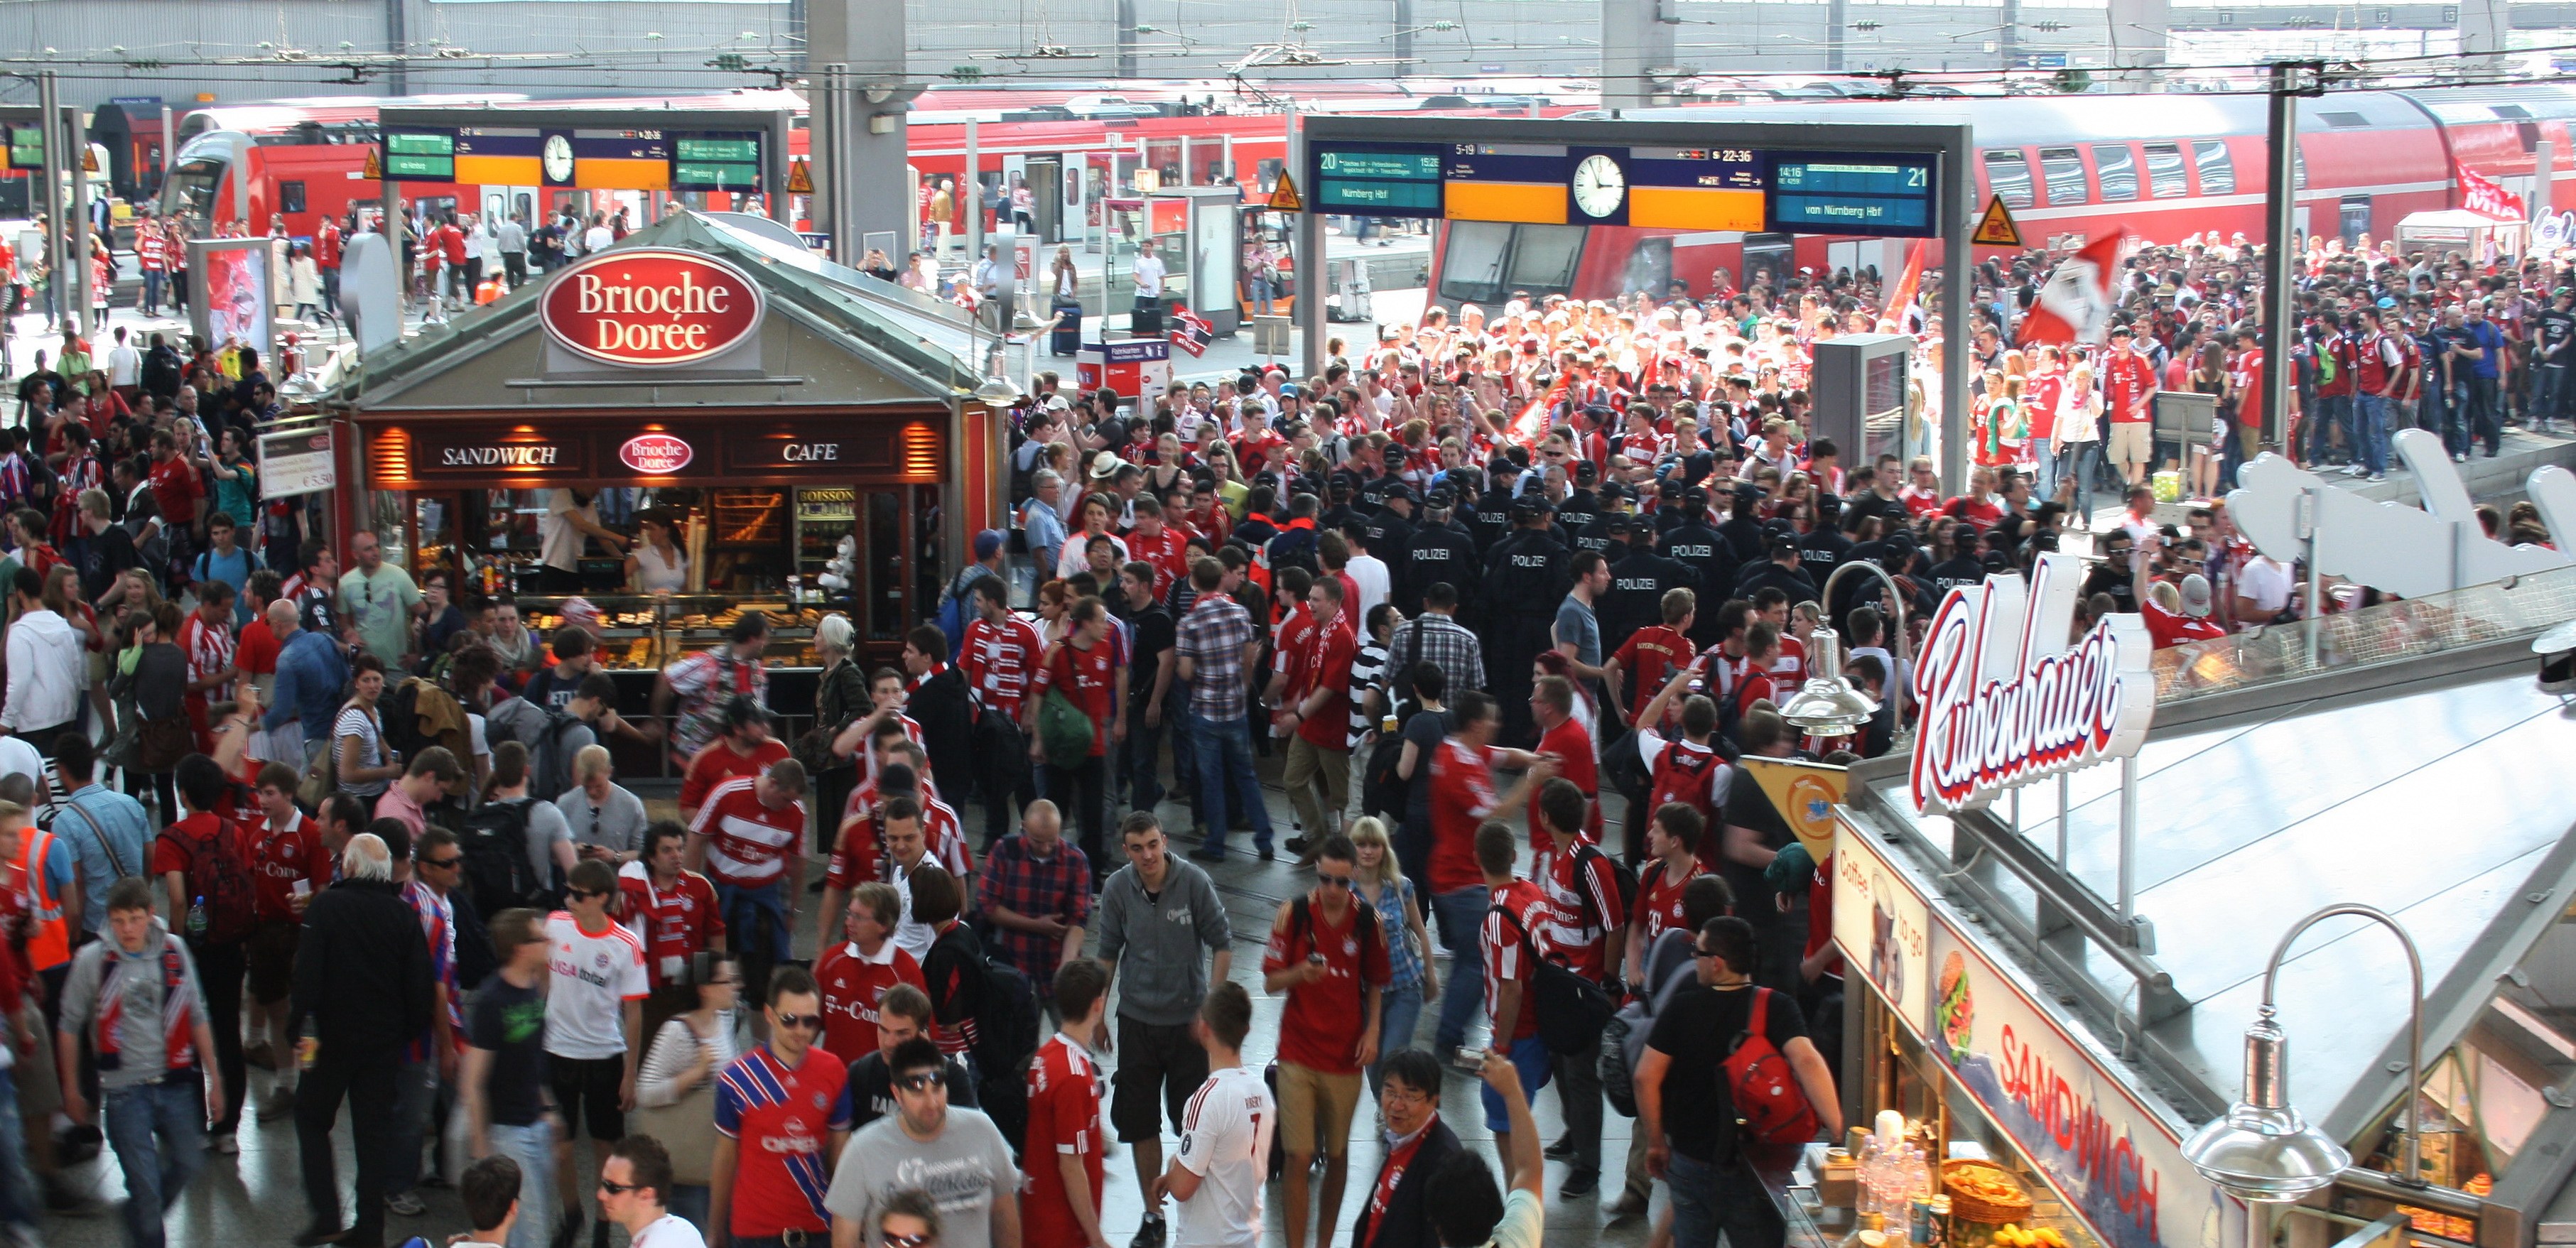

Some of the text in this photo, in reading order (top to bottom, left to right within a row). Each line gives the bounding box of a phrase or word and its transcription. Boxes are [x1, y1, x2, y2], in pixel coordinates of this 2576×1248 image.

[1456, 143, 1476, 155] 5-19
[1722, 150, 1753, 162] 22-36
[1320, 153, 1336, 170] 20
[960, 173, 967, 186] 2
[1778, 167, 1803, 178] 14:16
[1907, 168, 1927, 188] 21
[1341, 188, 1388, 201] Nürnberg Hbf
[1805, 205, 1883, 219] von Nürnberg Hbf
[576, 271, 731, 314] Brioche
[596, 312, 708, 351] Dorée
[442, 446, 558, 465] SANDWICH
[631, 442, 684, 458] Brioche
[783, 443, 840, 462] CAFE
[1412, 548, 1451, 560] POLIZEI
[1672, 545, 1712, 557] POLIZEI
[1616, 578, 1656, 590] POLIZEI
[1911, 558, 2122, 812] Rubenbauer
[1839, 849, 1869, 899] Coffee
[1898, 909, 1922, 957] to go
[1249, 1112, 1262, 1158] 7
[2000, 1023, 2158, 1243] SANDWICH
